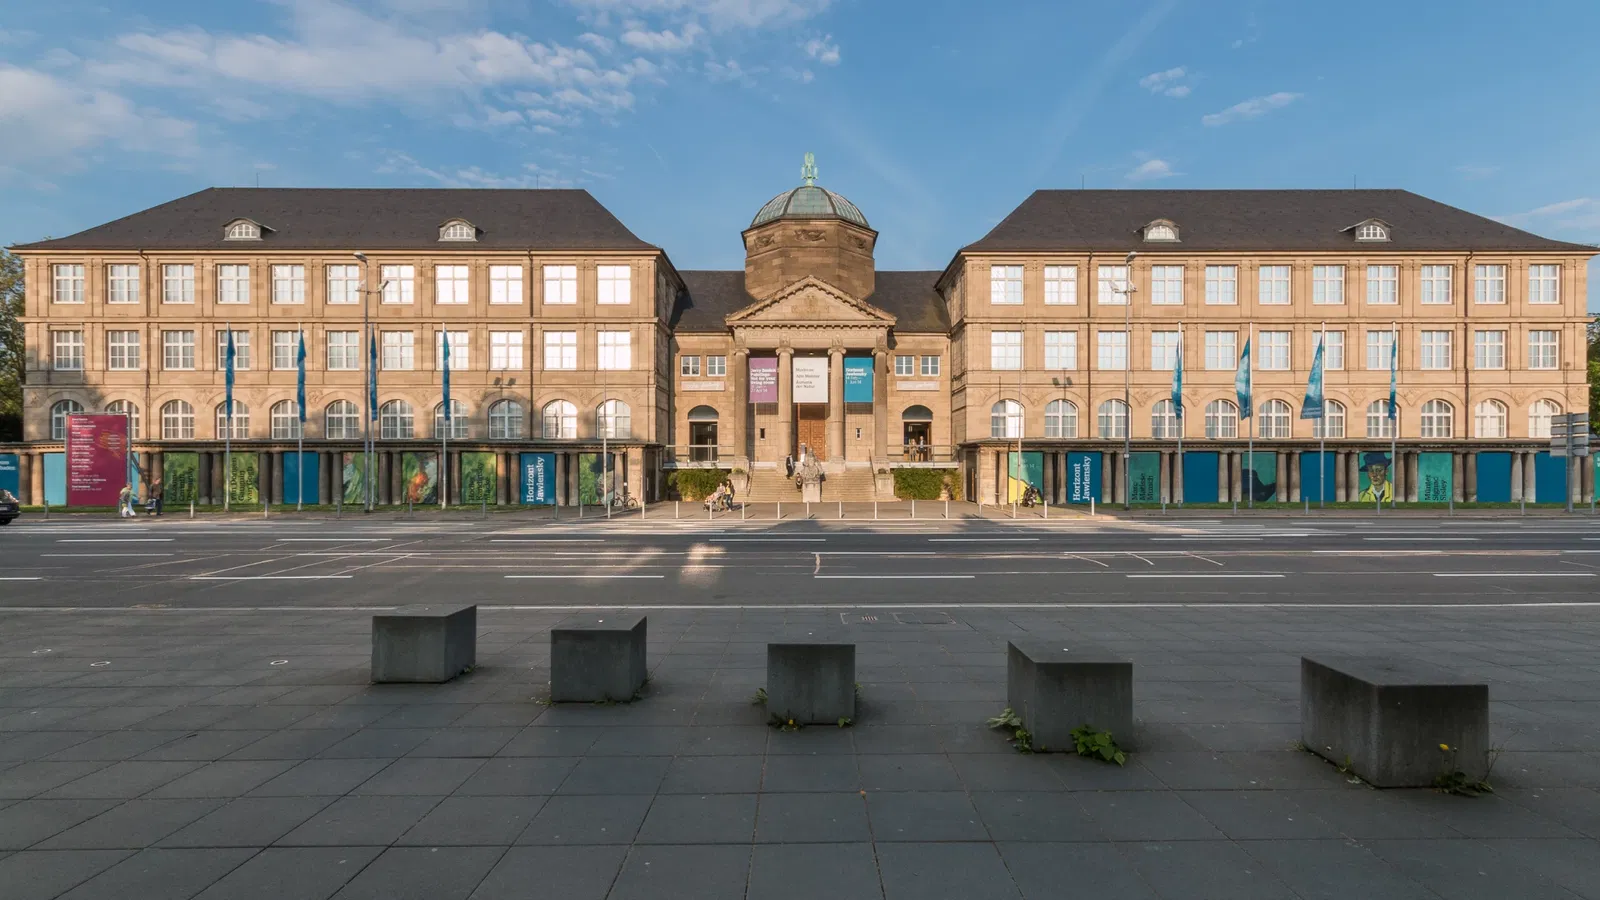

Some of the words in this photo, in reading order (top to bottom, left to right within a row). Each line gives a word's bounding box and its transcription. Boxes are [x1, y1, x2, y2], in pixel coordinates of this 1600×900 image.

[230, 457, 238, 485] Dongen
[238, 470, 246, 501] Gauguin
[246, 466, 254, 485] Gogh
[526, 464, 535, 502] Horizont
[536, 456, 545, 502] Jawlensky
[1072, 463, 1081, 501] Horizont
[1082, 455, 1092, 501] Jawlensky
[1432, 476, 1440, 501] Signac
[1440, 479, 1448, 501] Sisley
